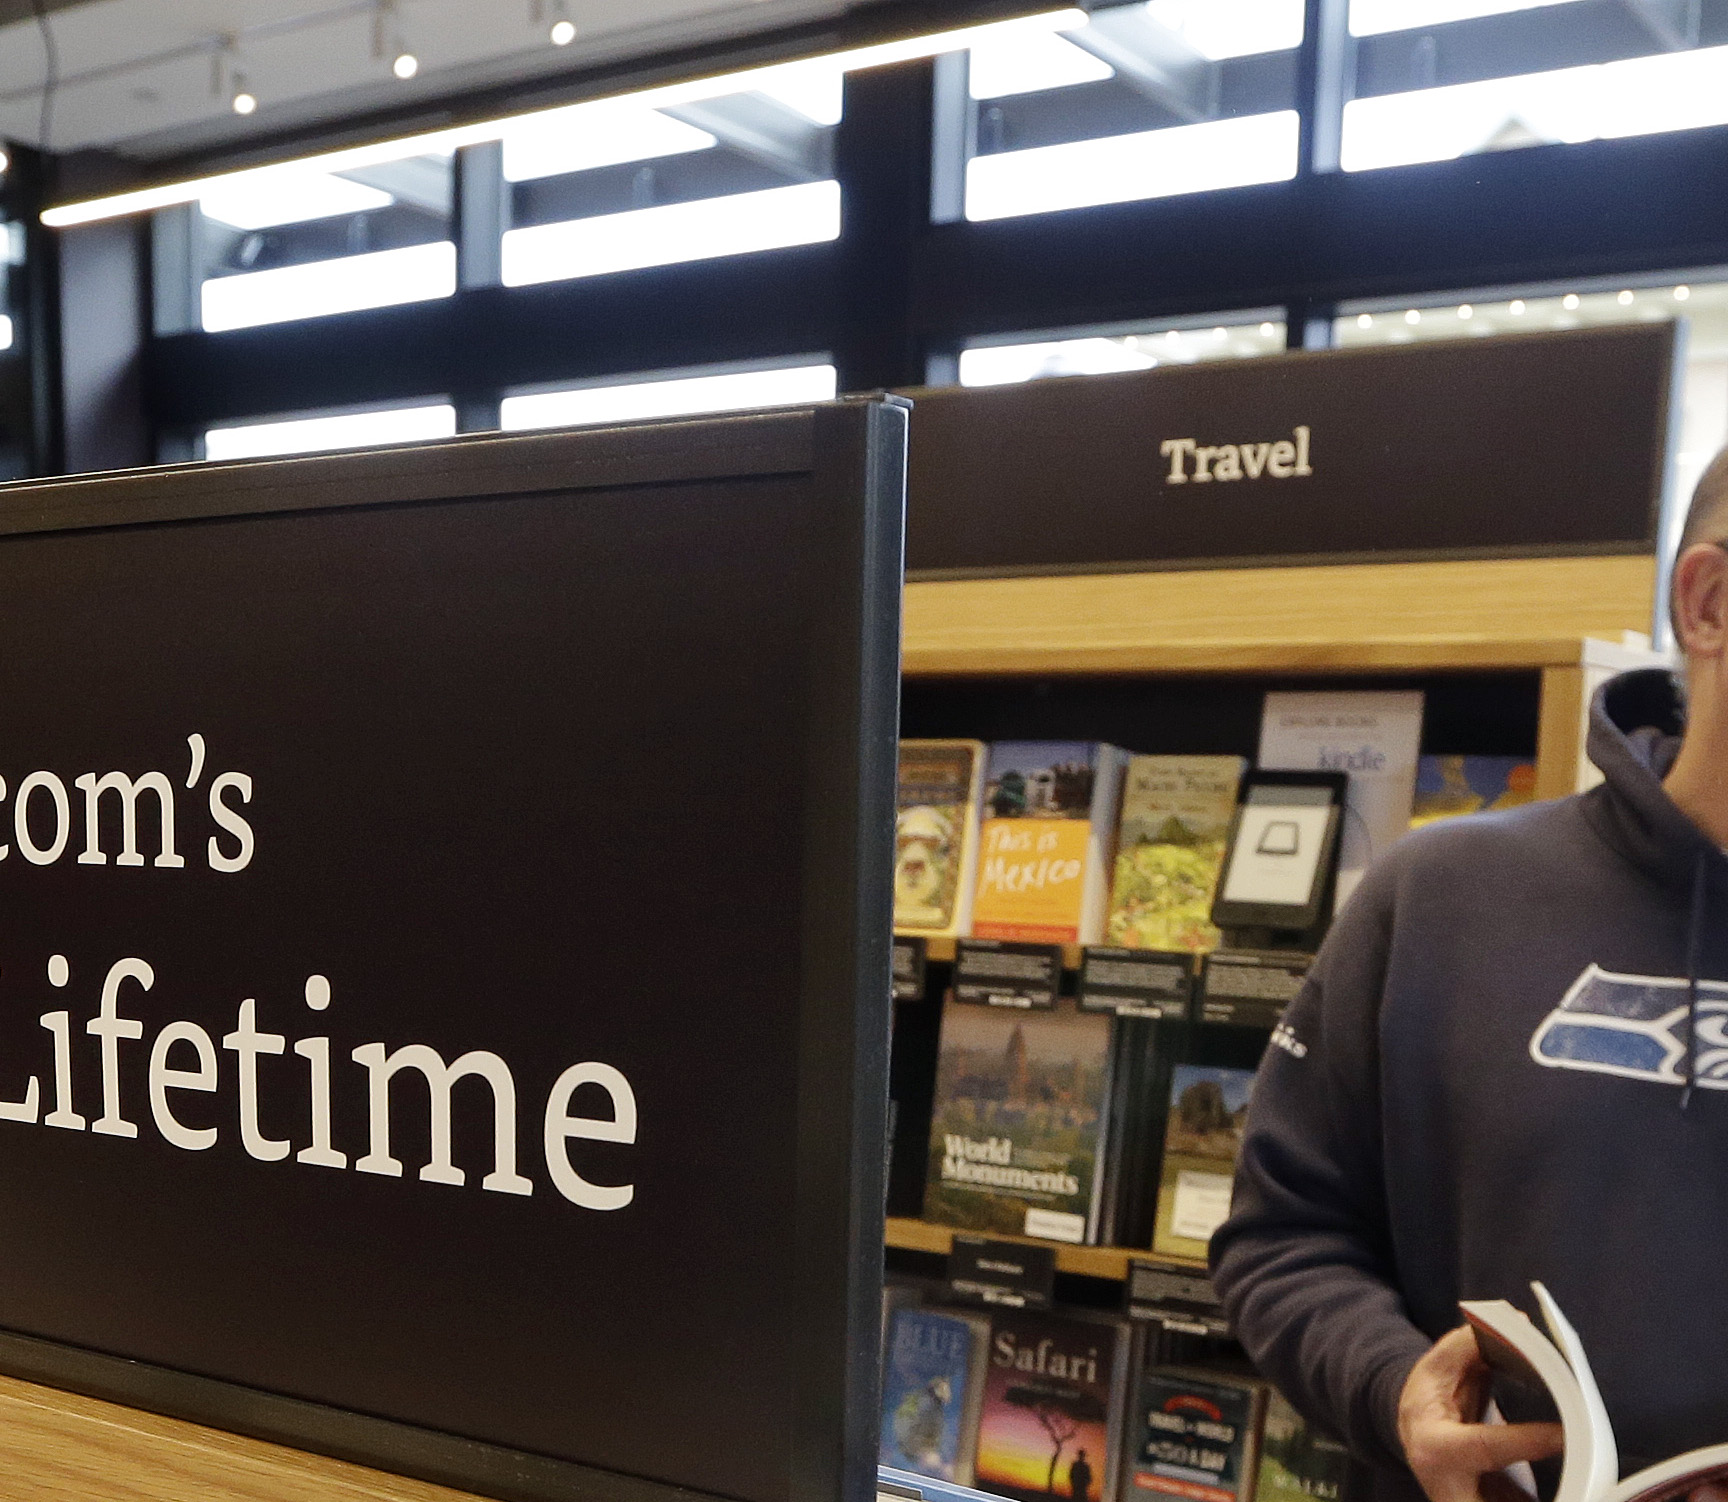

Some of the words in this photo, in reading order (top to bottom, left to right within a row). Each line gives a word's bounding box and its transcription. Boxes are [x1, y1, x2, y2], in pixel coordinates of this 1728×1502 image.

[1160, 425, 1313, 486] Travel
[942, 1133, 1012, 1165] World
[941, 1155, 1080, 1197] Monuments
[992, 1333, 1098, 1384] Safari
